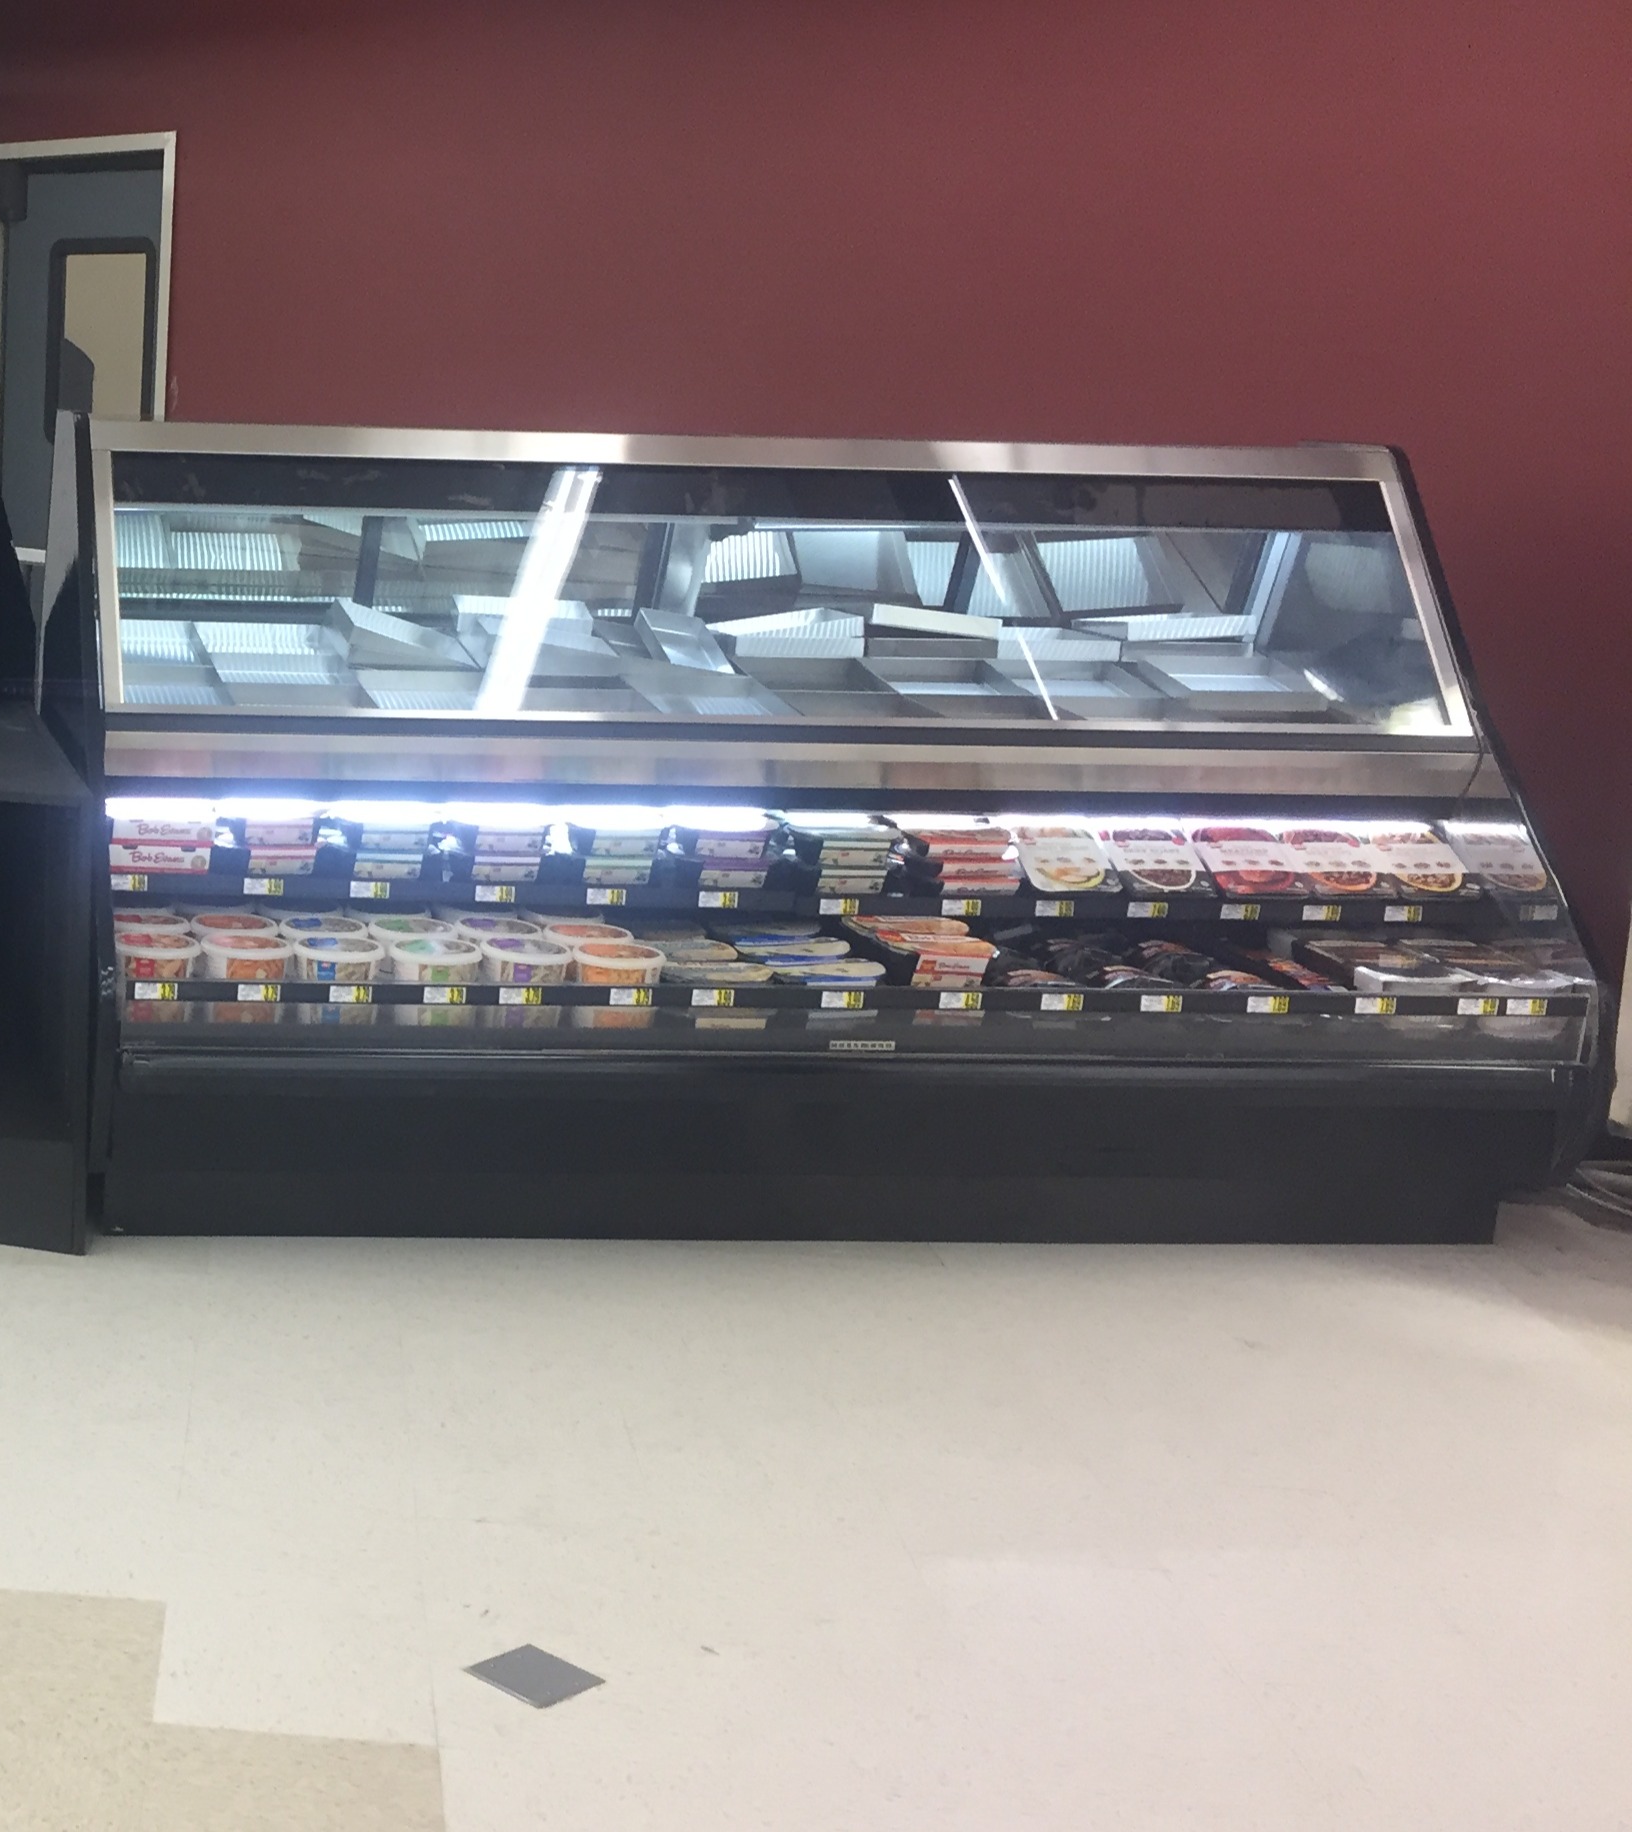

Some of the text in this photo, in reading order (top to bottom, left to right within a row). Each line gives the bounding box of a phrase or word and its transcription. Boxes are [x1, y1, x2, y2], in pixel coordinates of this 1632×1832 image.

[137, 823, 192, 836] Bob Evans
[128, 851, 185, 864] Bob Evans
